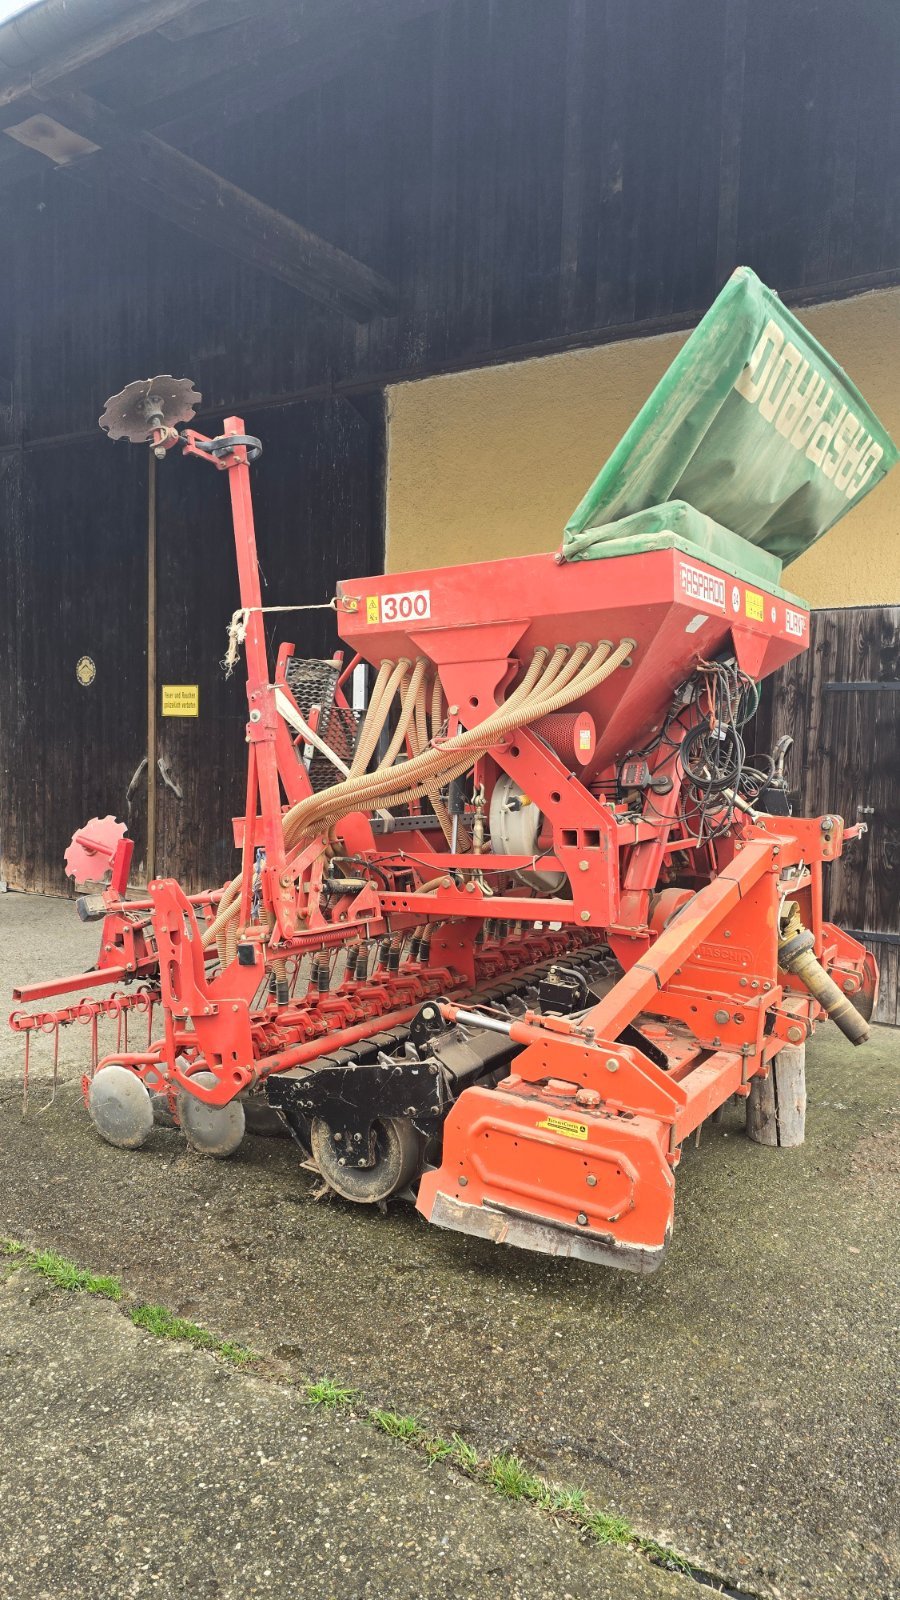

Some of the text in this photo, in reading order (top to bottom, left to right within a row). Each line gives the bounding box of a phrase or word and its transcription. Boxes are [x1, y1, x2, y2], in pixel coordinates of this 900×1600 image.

[733, 318, 884, 501] GASPARDO
[680, 565, 725, 605] GASPARDO
[384, 594, 428, 620] 300
